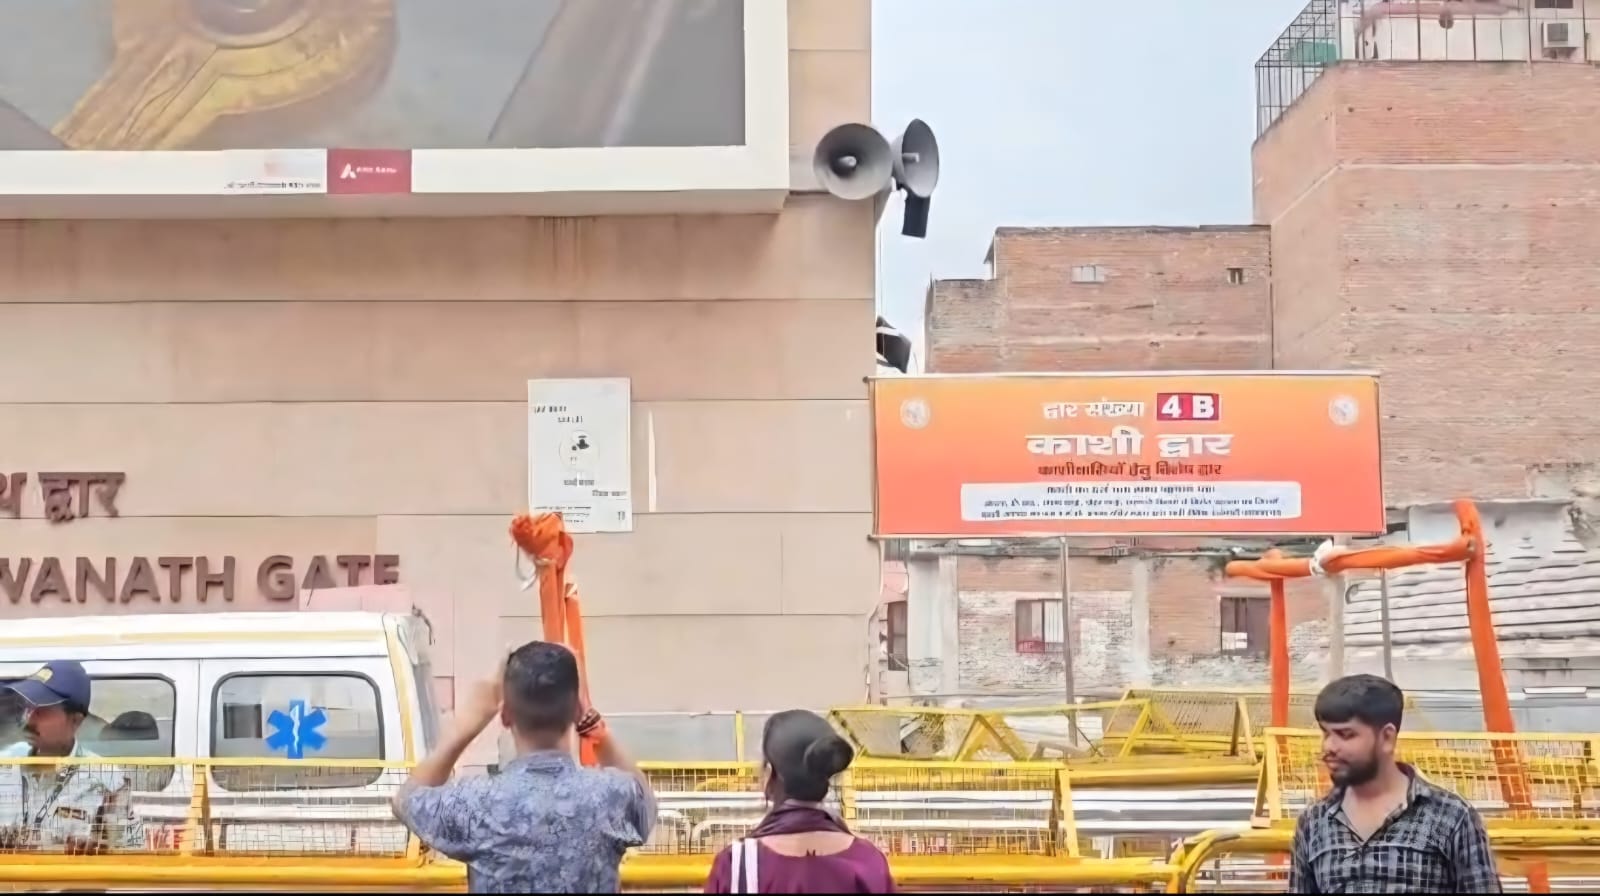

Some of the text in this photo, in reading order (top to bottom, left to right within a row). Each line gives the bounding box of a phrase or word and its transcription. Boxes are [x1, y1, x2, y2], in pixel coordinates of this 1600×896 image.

[1161, 395, 1181, 418] 4
[1192, 395, 1215, 419] B
[1025, 426, 1234, 458] काशी द्वार
[37, 471, 126, 524] द्वार
[256, 554, 400, 601] GATE
